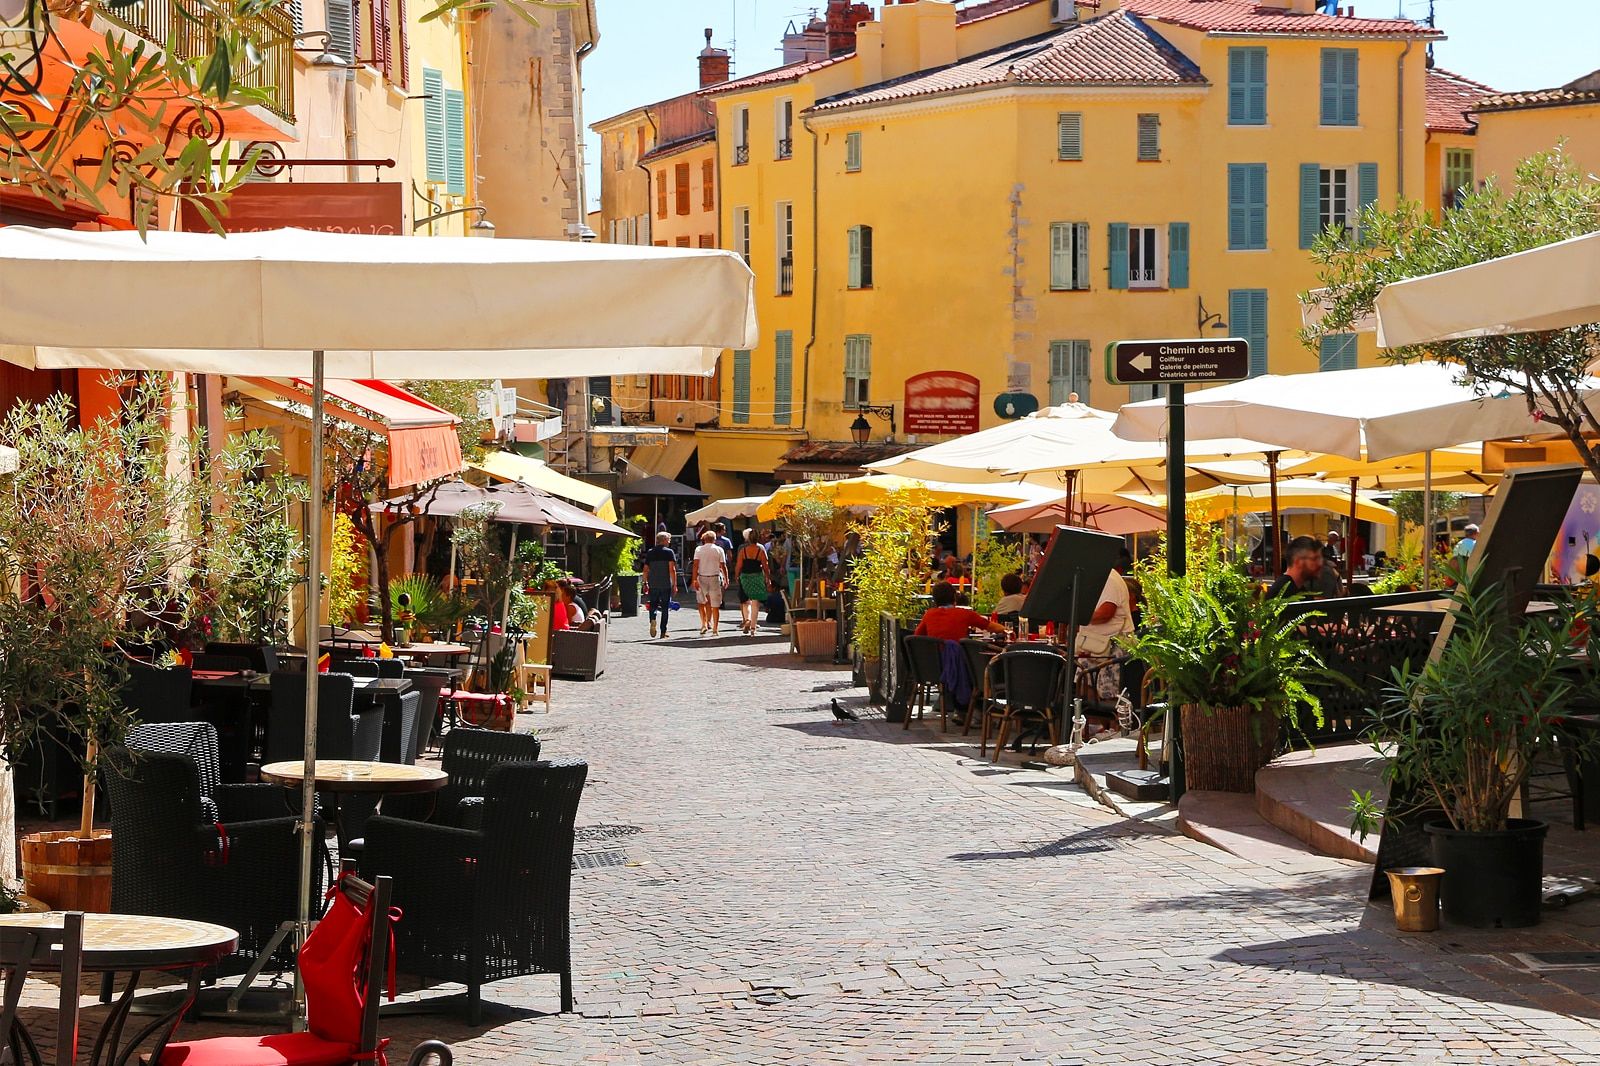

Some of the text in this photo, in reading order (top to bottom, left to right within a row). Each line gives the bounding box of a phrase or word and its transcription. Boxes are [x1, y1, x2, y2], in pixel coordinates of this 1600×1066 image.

[1159, 345, 1236, 354] Chemin des arts
